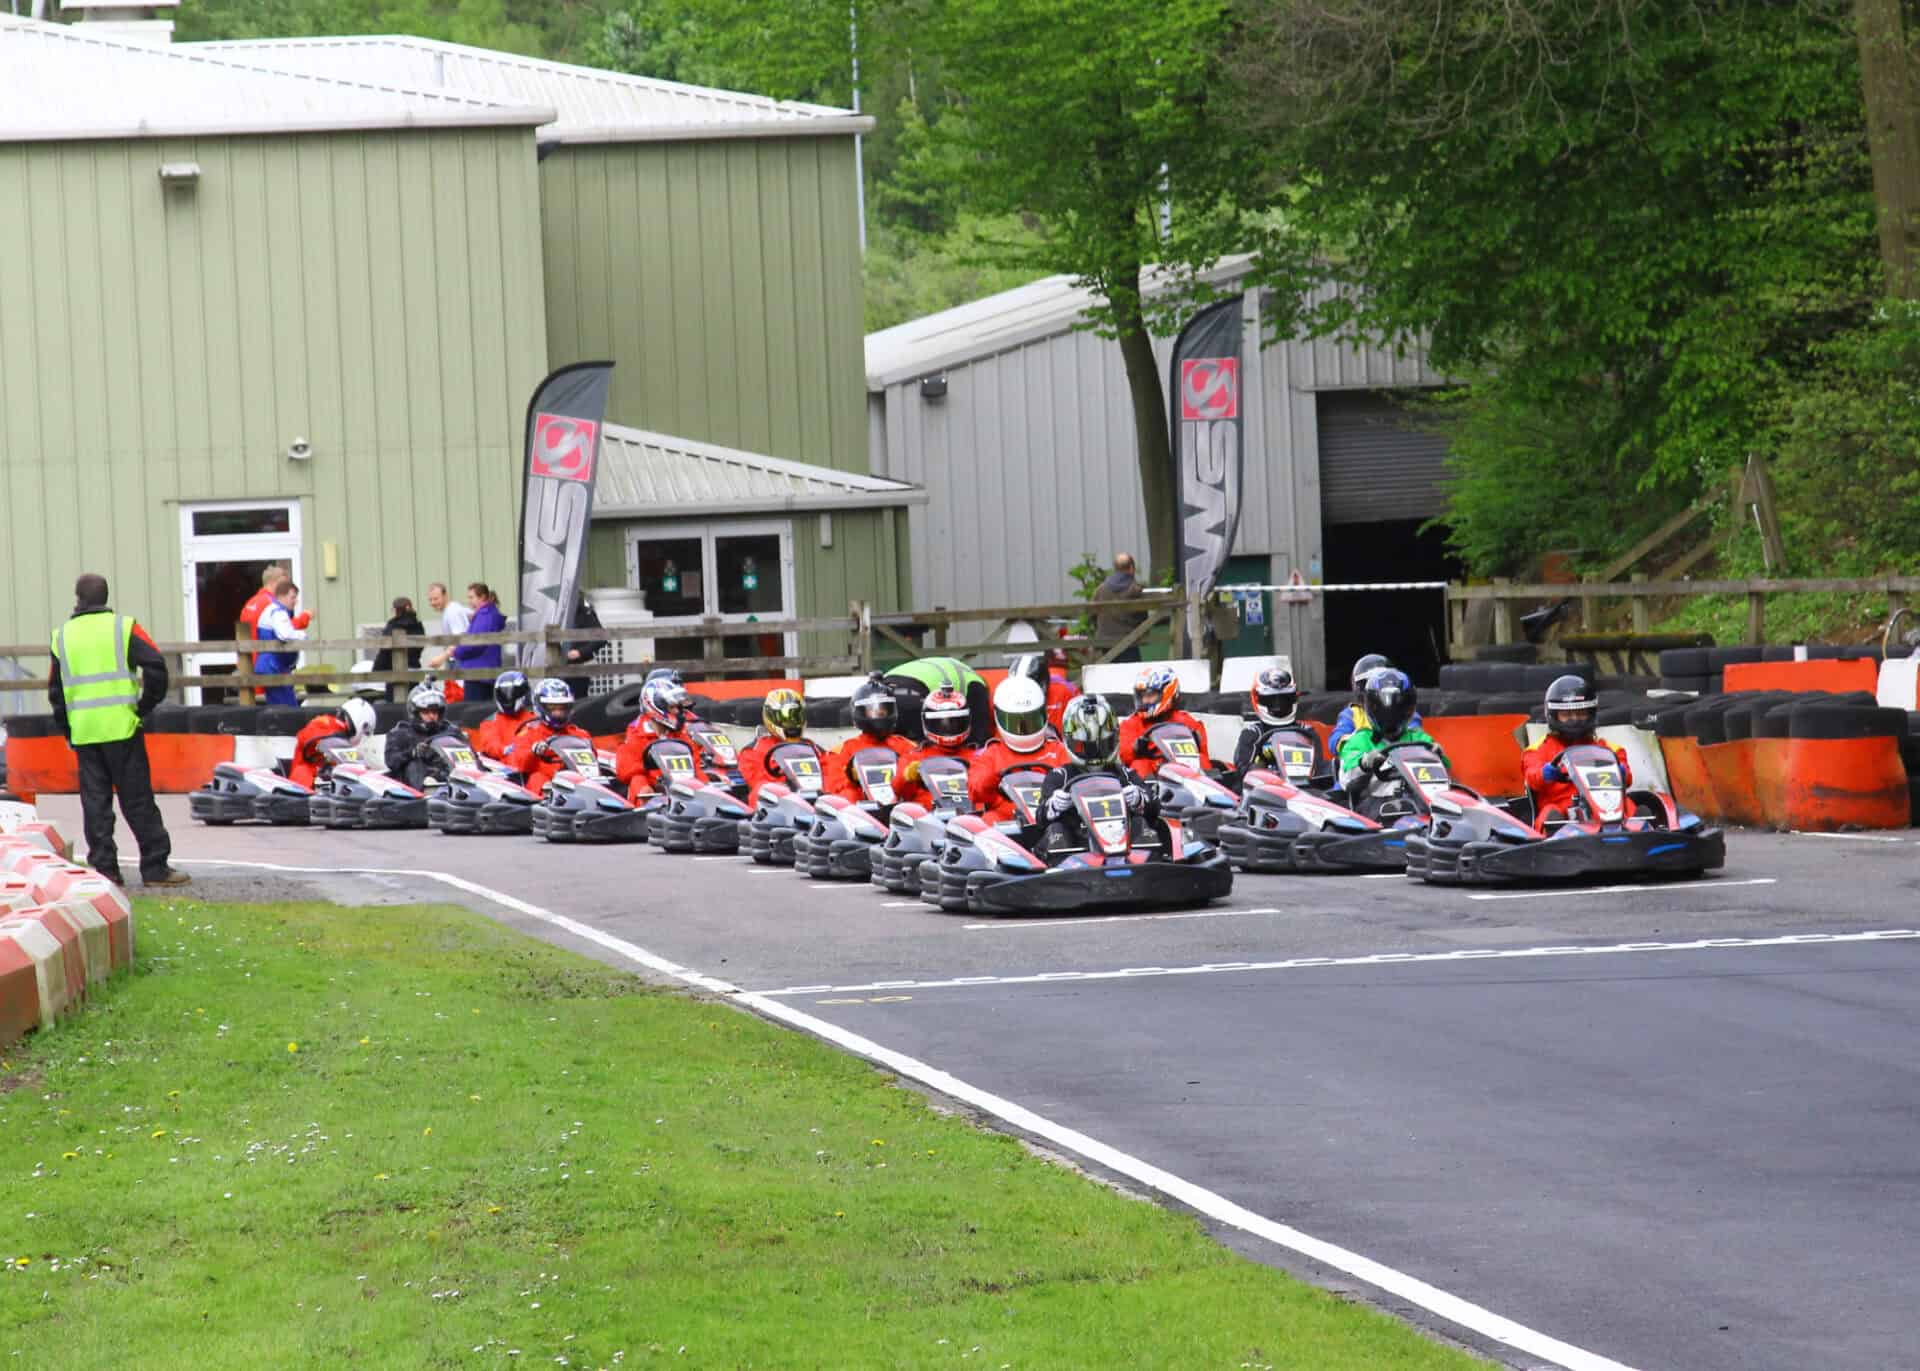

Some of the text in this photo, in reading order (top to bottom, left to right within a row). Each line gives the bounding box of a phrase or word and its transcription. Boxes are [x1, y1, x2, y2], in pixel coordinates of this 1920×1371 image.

[670, 757, 689, 770] 11
[880, 768, 892, 784] 7
[1418, 767, 1431, 780] 4
[1597, 772, 1612, 786] 2
[1100, 800, 1110, 817] 1
